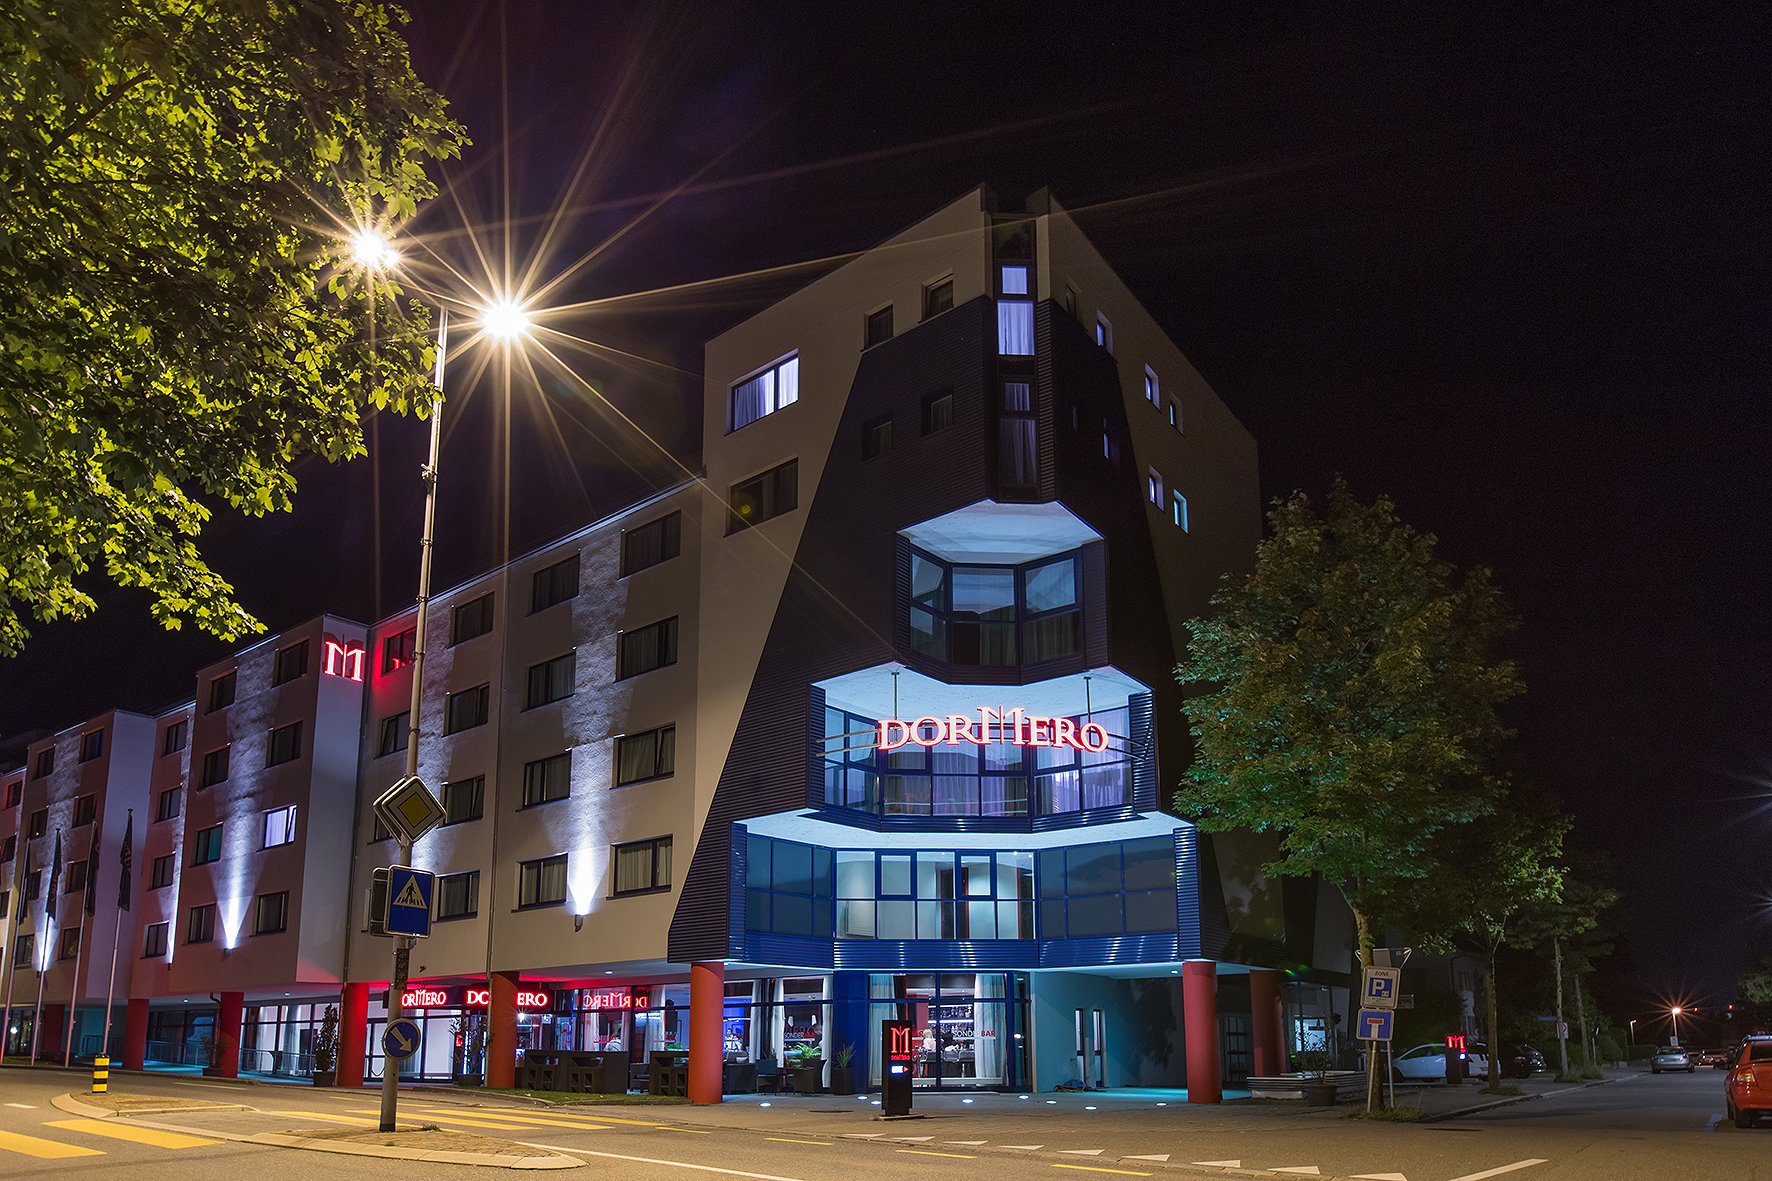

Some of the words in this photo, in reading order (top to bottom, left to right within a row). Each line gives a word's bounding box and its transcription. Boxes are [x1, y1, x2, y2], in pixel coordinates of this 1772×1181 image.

[324, 641, 366, 683] M
[877, 704, 1109, 753] DORMERO
[401, 989, 447, 1007] ORMERO
[890, 1026, 911, 1054] M
